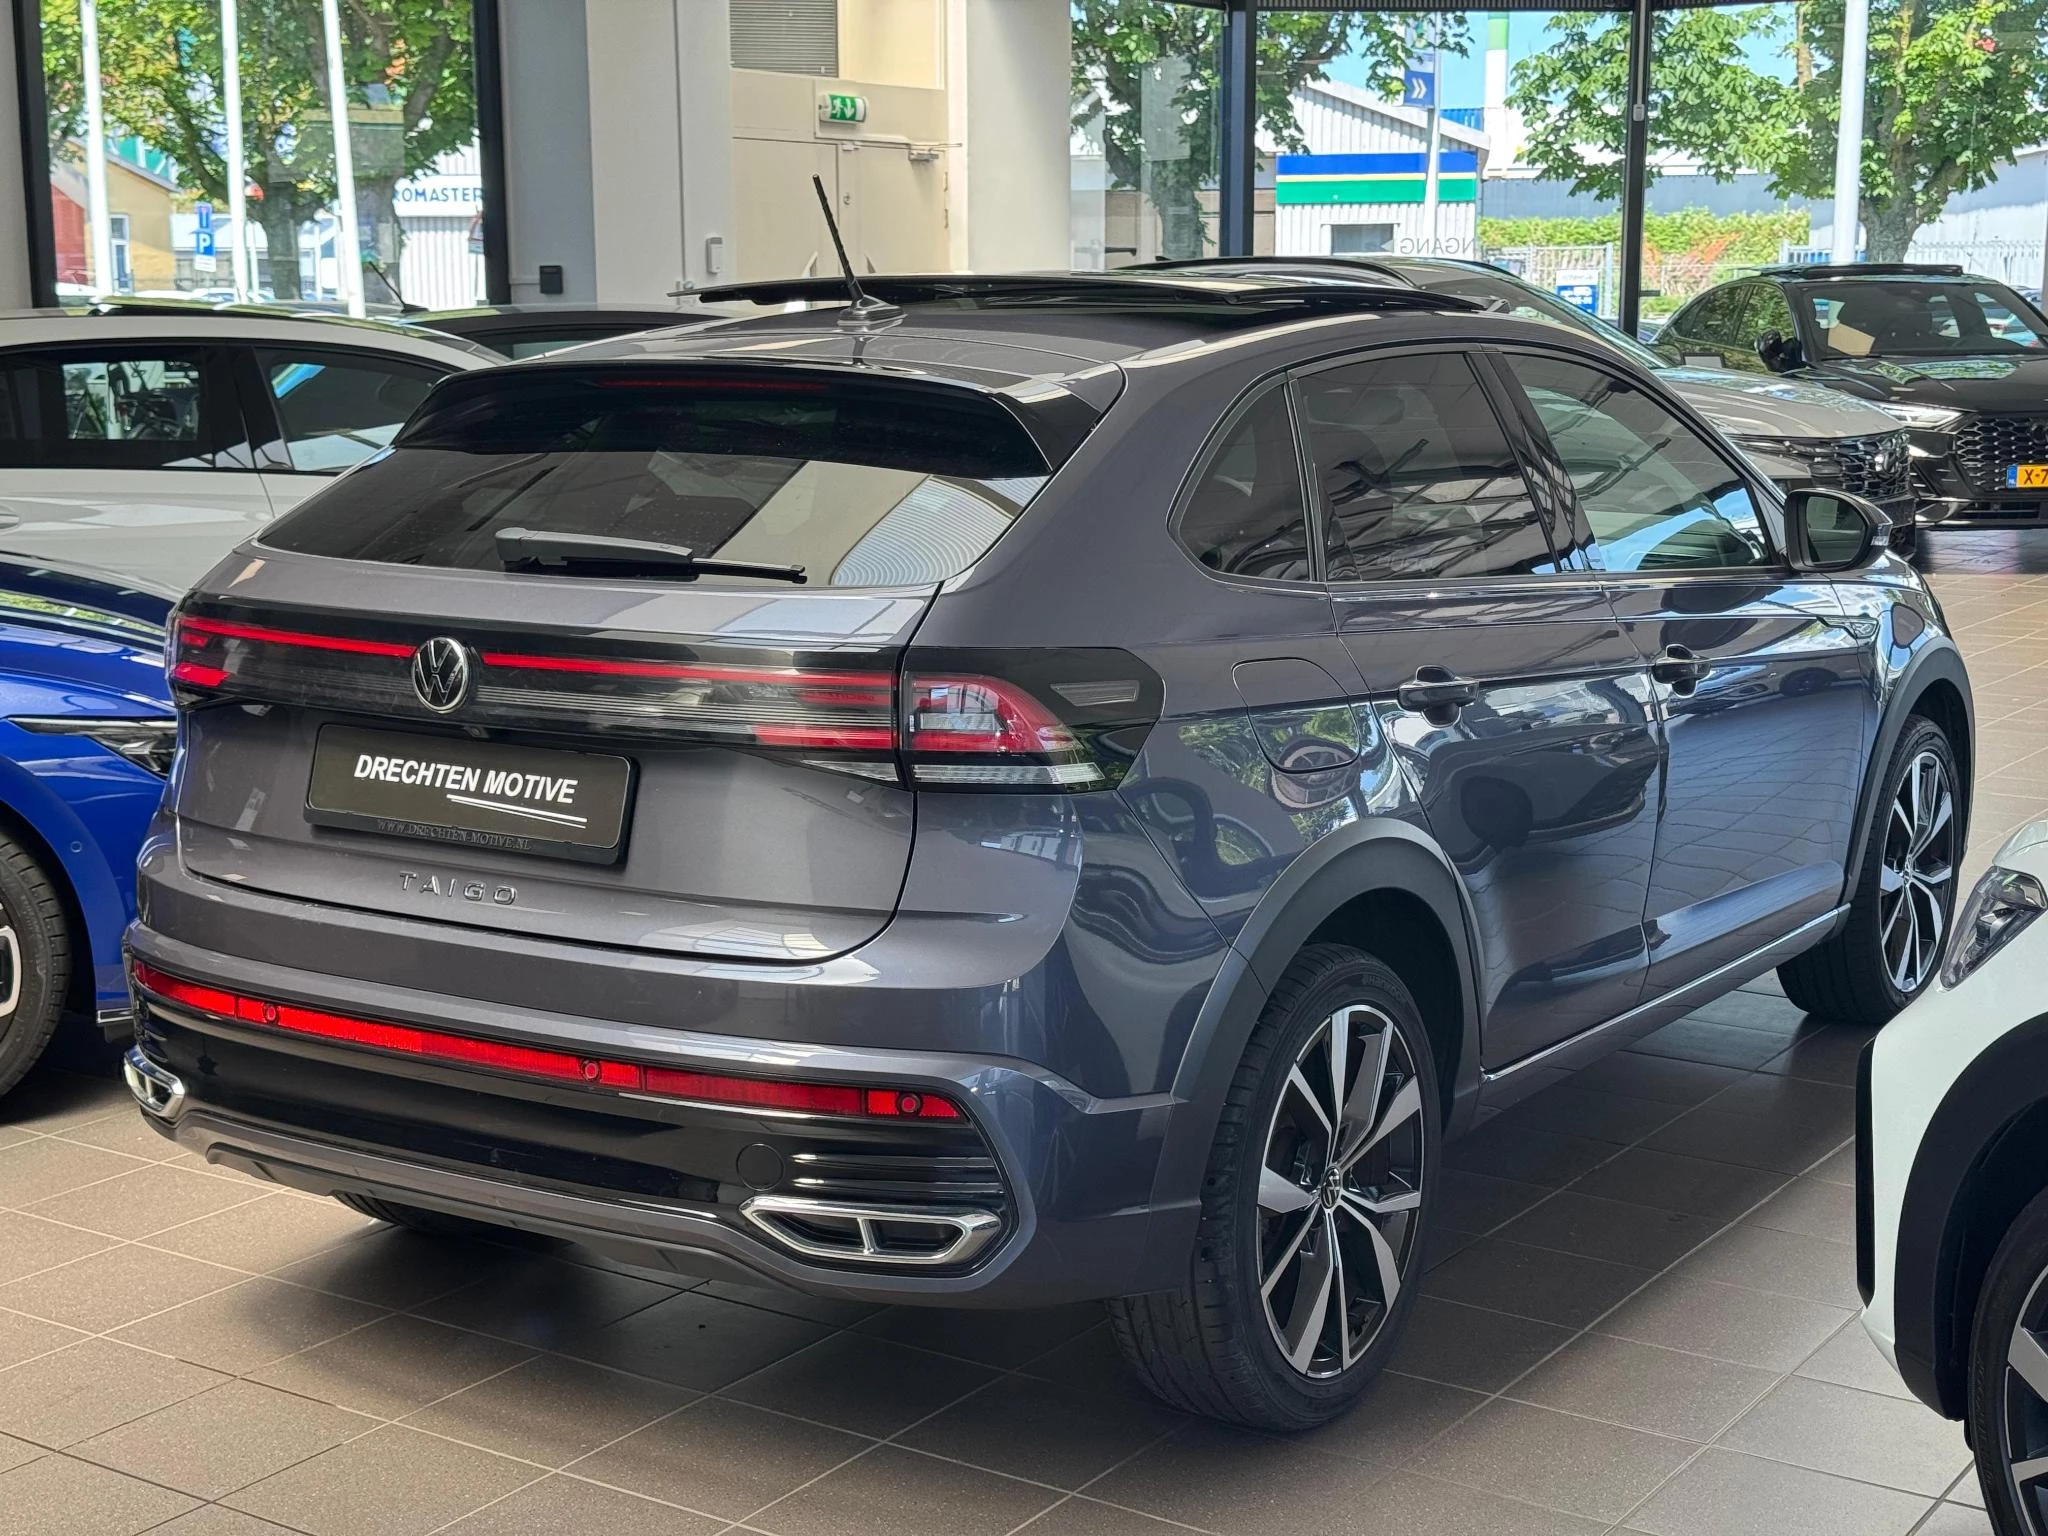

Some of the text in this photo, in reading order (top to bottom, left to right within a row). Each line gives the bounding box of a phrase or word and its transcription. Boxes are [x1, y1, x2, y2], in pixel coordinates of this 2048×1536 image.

[199, 233, 211, 253] P
[354, 754, 579, 804] DRECHTEN MOTIVE
[376, 818, 532, 851] WWW.DRECHTEN-MOTIVE.NL
[400, 872, 518, 906] TAIGO
